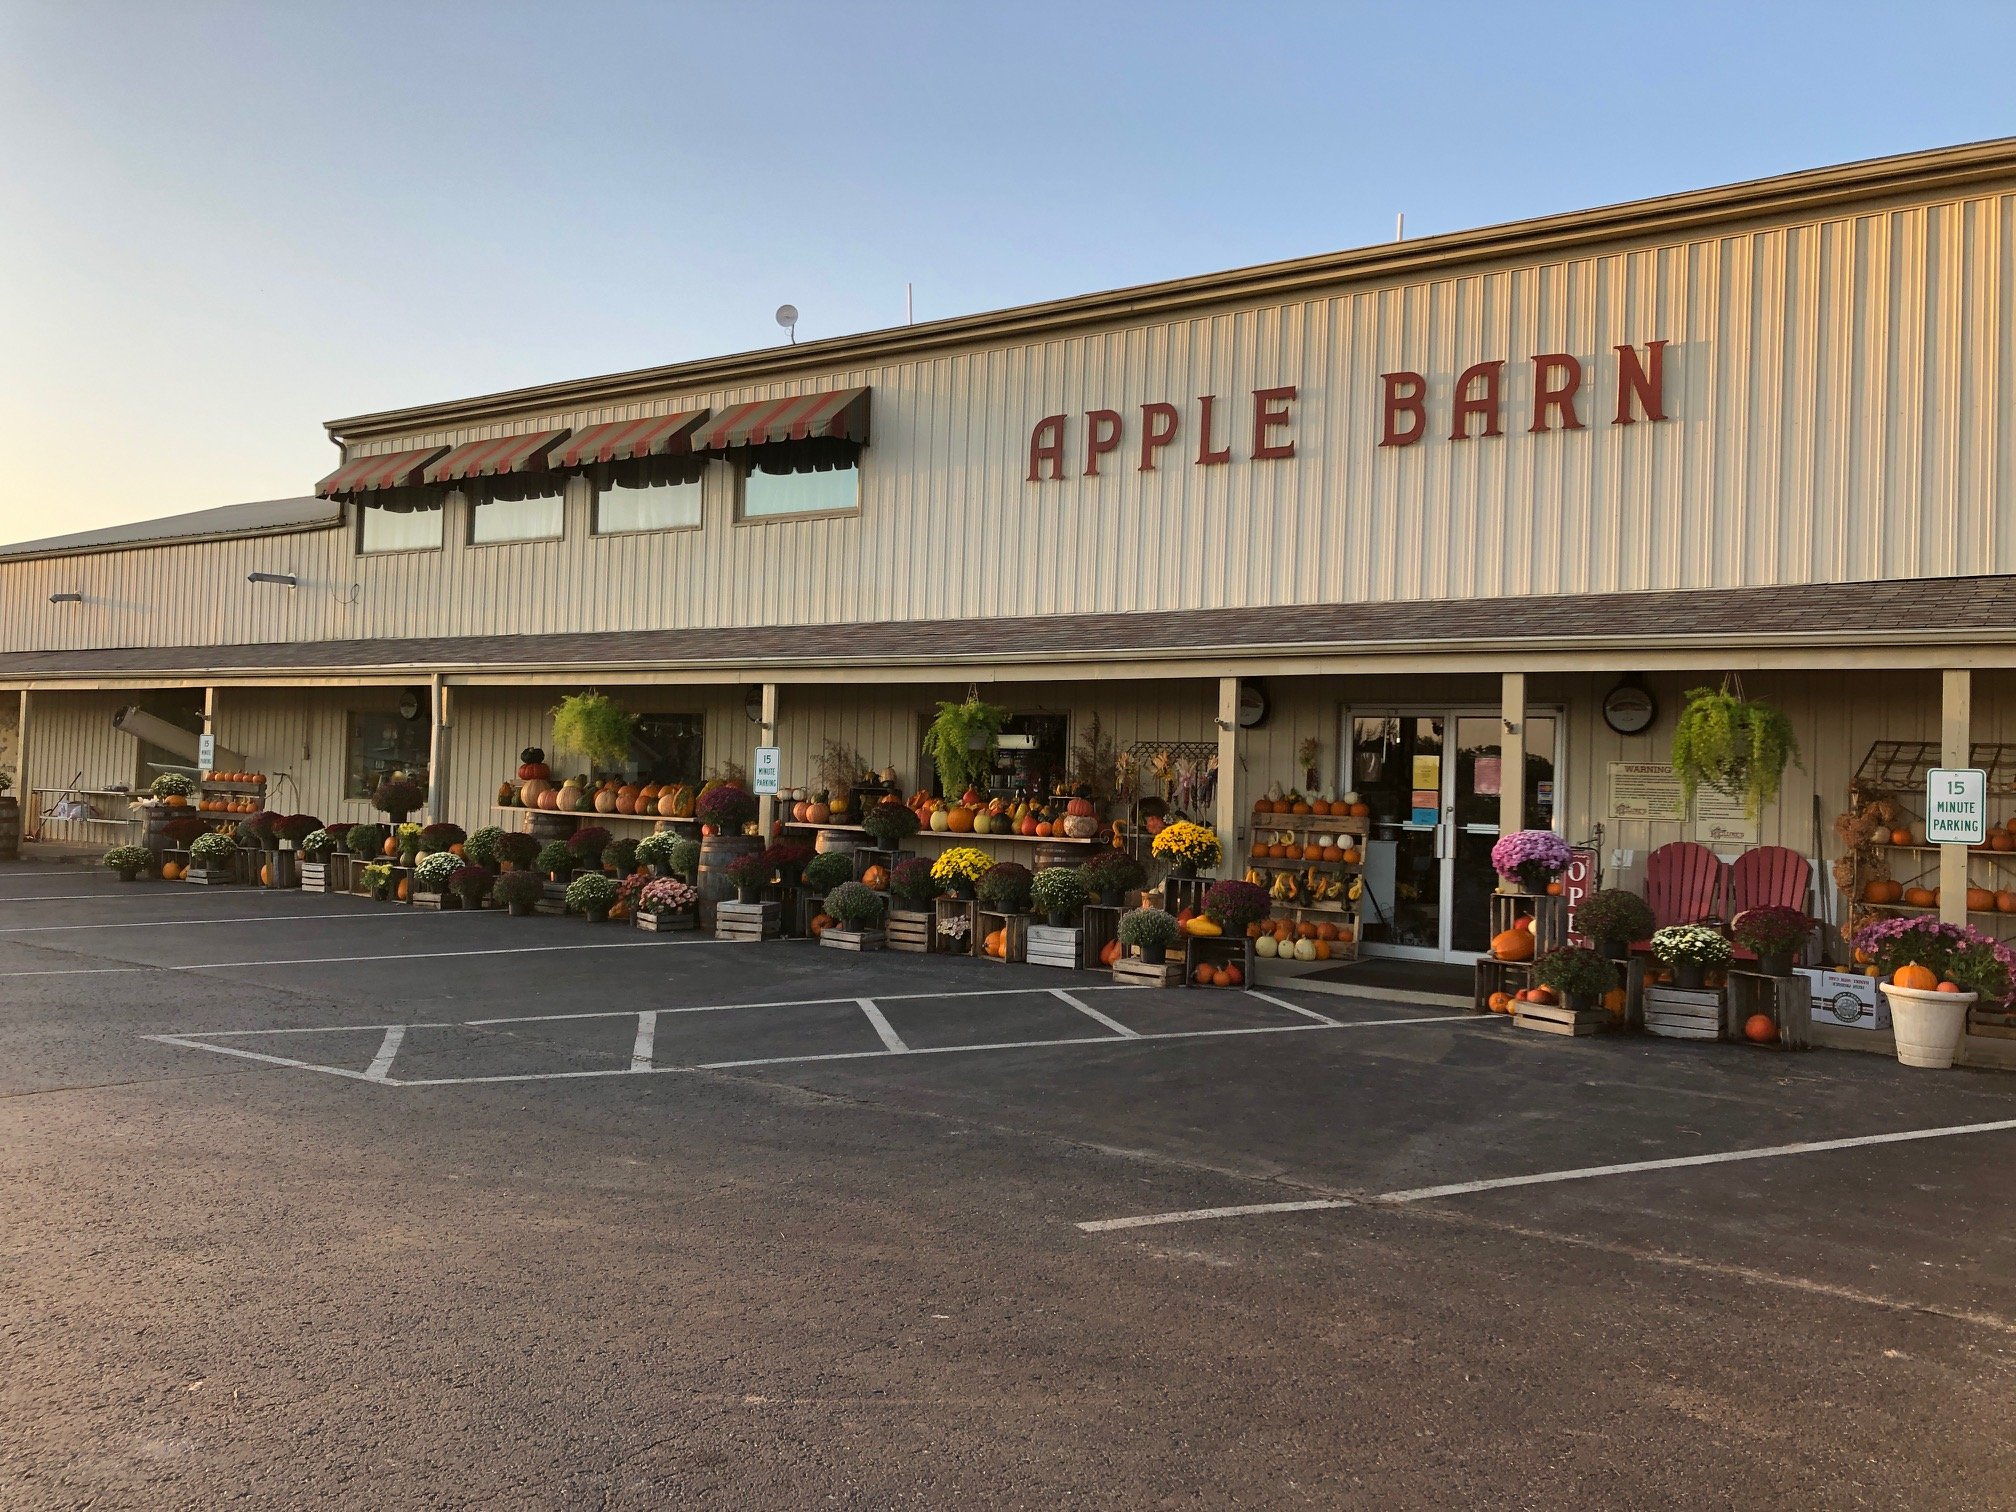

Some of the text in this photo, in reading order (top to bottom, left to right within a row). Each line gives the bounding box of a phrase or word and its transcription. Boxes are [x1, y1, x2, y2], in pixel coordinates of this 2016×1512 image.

[1026, 339, 1670, 482] APPLE BARN
[763, 754, 772, 764] 15
[758, 767, 776, 776] MINUTE
[1624, 766, 1672, 774] WARNING
[756, 779, 777, 788] PARKING
[1947, 781, 1966, 795] 15
[1937, 801, 1976, 814] MINUTE
[1933, 819, 1979, 832] PARKING
